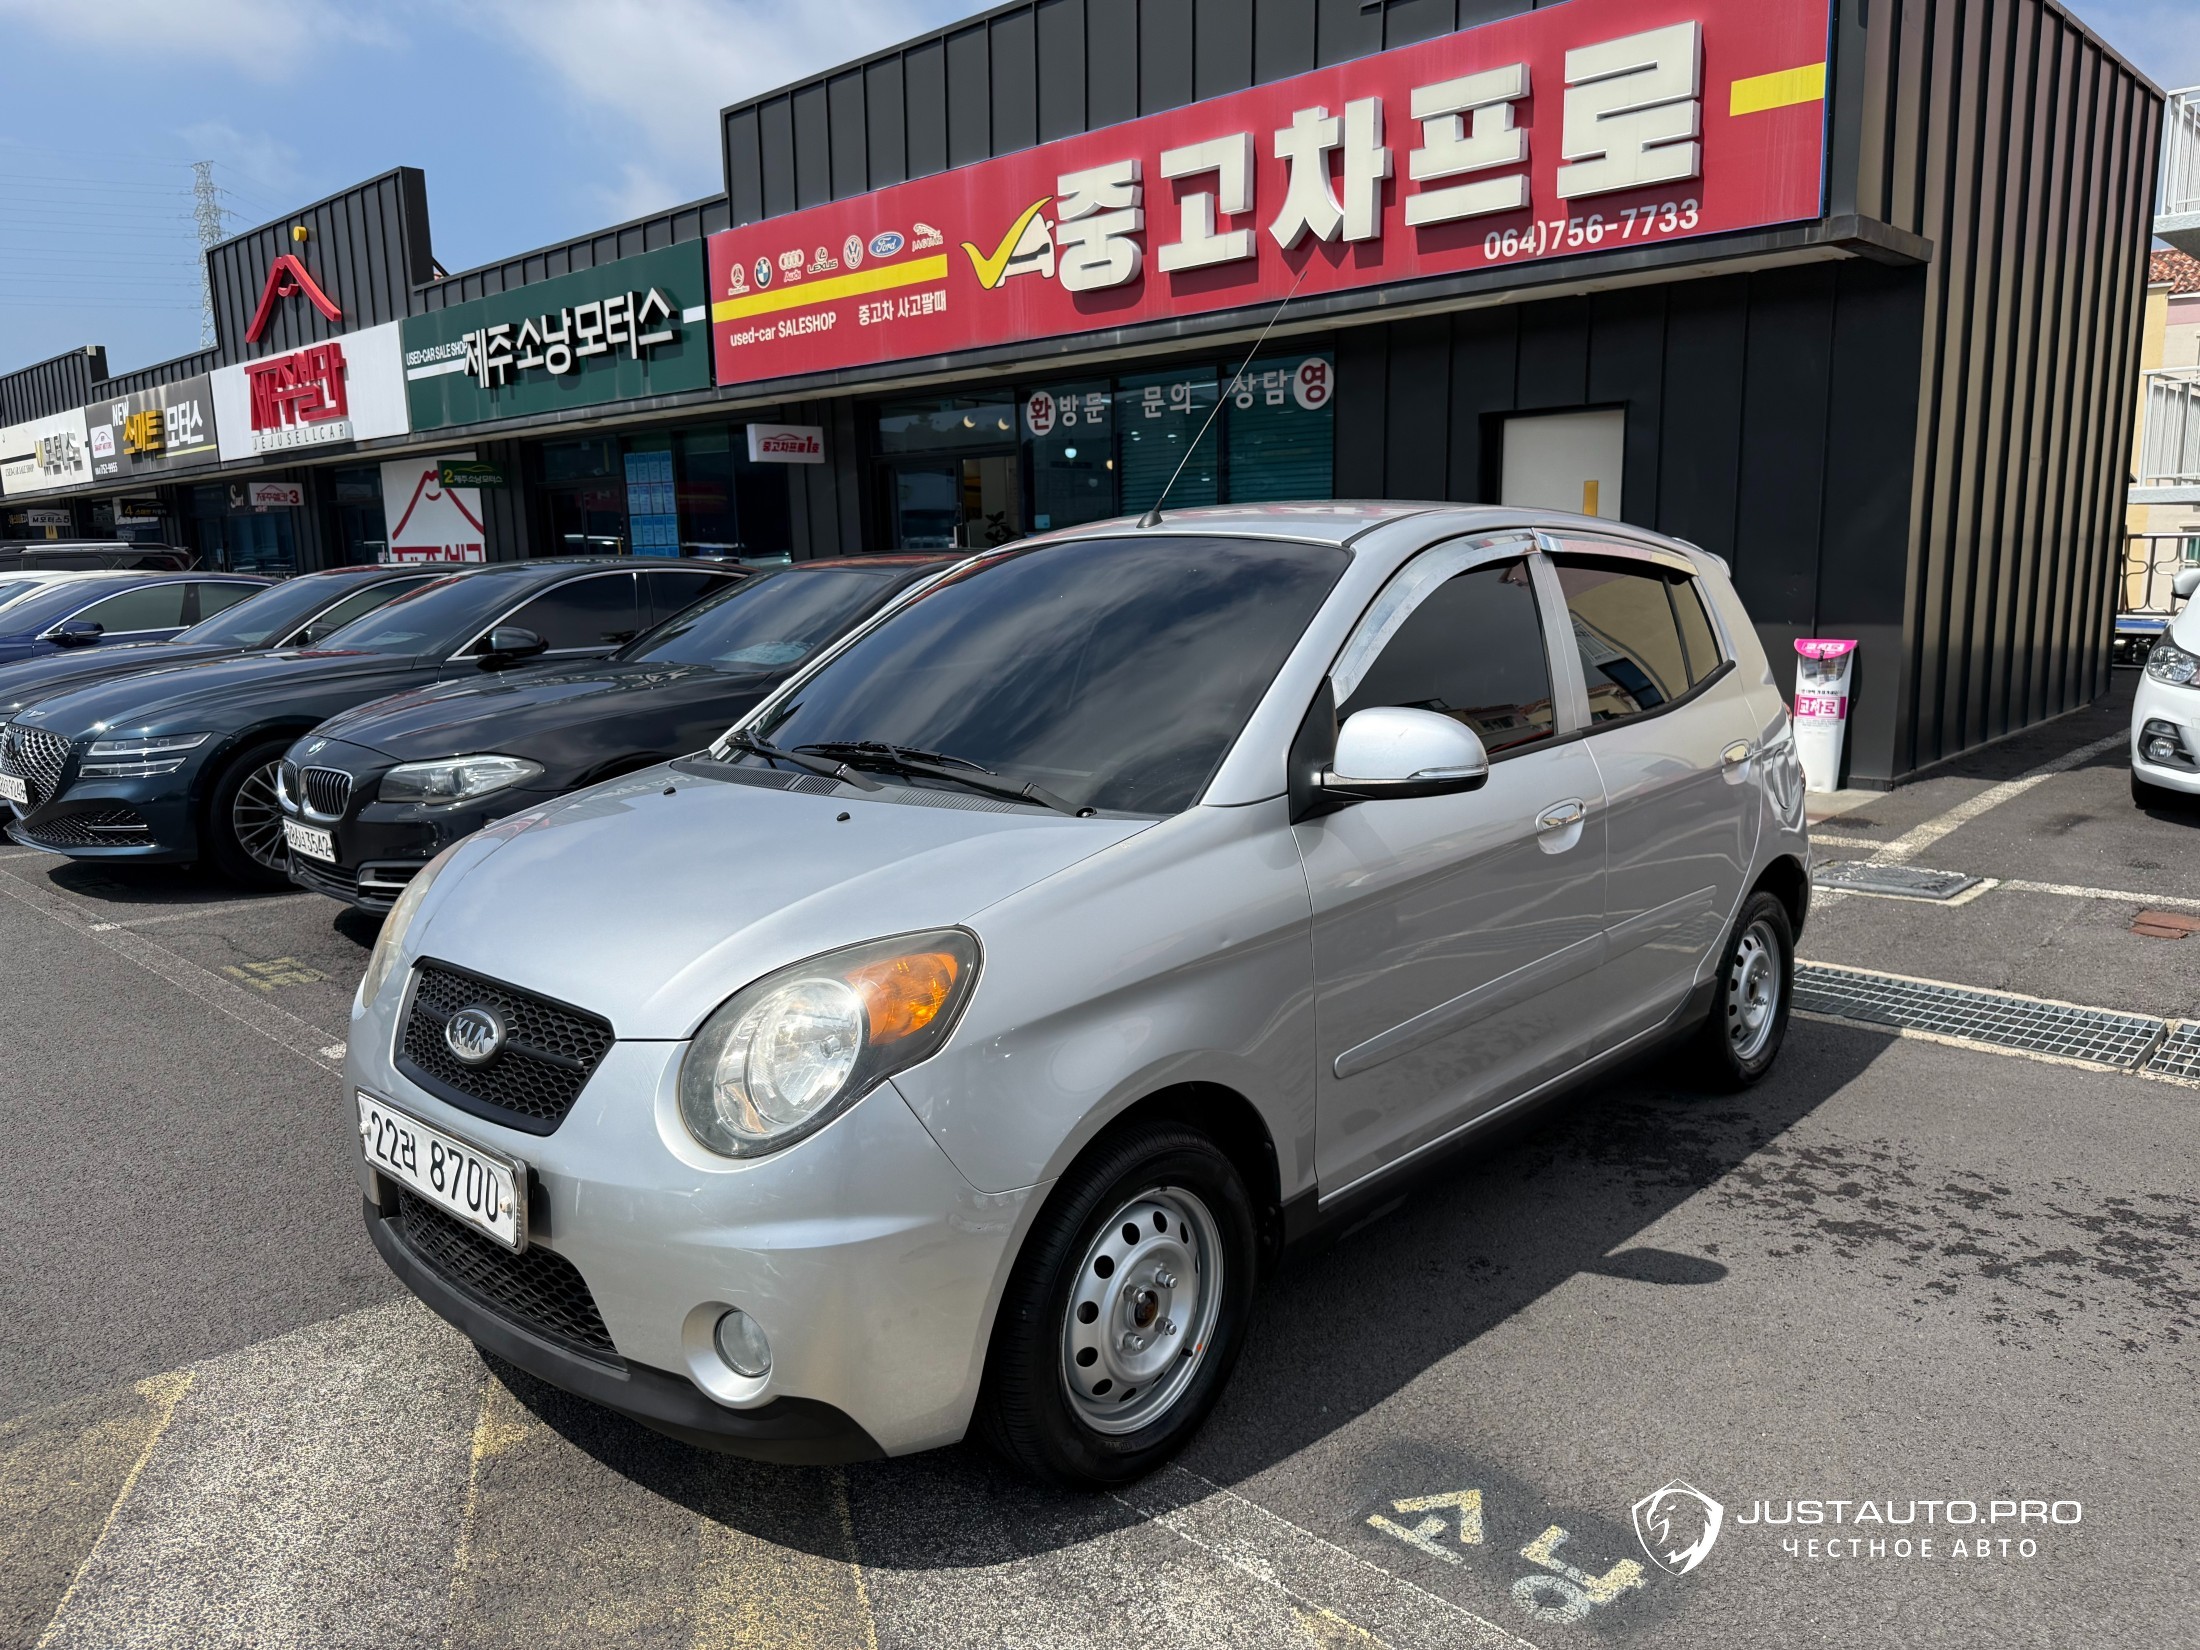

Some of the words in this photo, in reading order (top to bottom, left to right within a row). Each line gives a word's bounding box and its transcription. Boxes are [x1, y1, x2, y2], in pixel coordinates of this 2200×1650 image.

[1056, 19, 1703, 293] 중고차프로
[1484, 198, 1699, 261] 064)756-7733
[807, 258, 838, 274] LEXUS
[876, 237, 897, 252] Ford
[858, 300, 894, 326] 중고차
[897, 289, 947, 318] 사고팔때
[462, 287, 673, 388] 제주소낭모터스
[730, 326, 776, 346] used-car
[778, 311, 837, 338] SALESHOP
[406, 347, 436, 366] USED-CAR
[435, 343, 451, 360] SALE
[451, 339, 468, 356] SHOP
[112, 401, 129, 427] NEW
[1059, 392, 1105, 427] 방문
[1141, 382, 1191, 418] 문의
[1231, 369, 1287, 409] 상담
[123, 410, 163, 455] 스마트
[167, 400, 204, 448] 모터스
[253, 423, 345, 451] JEJUSELLCAR
[456, 1016, 488, 1054] KIA
[371, 1111, 418, 1177] 22러
[430, 1139, 499, 1222] 8700
